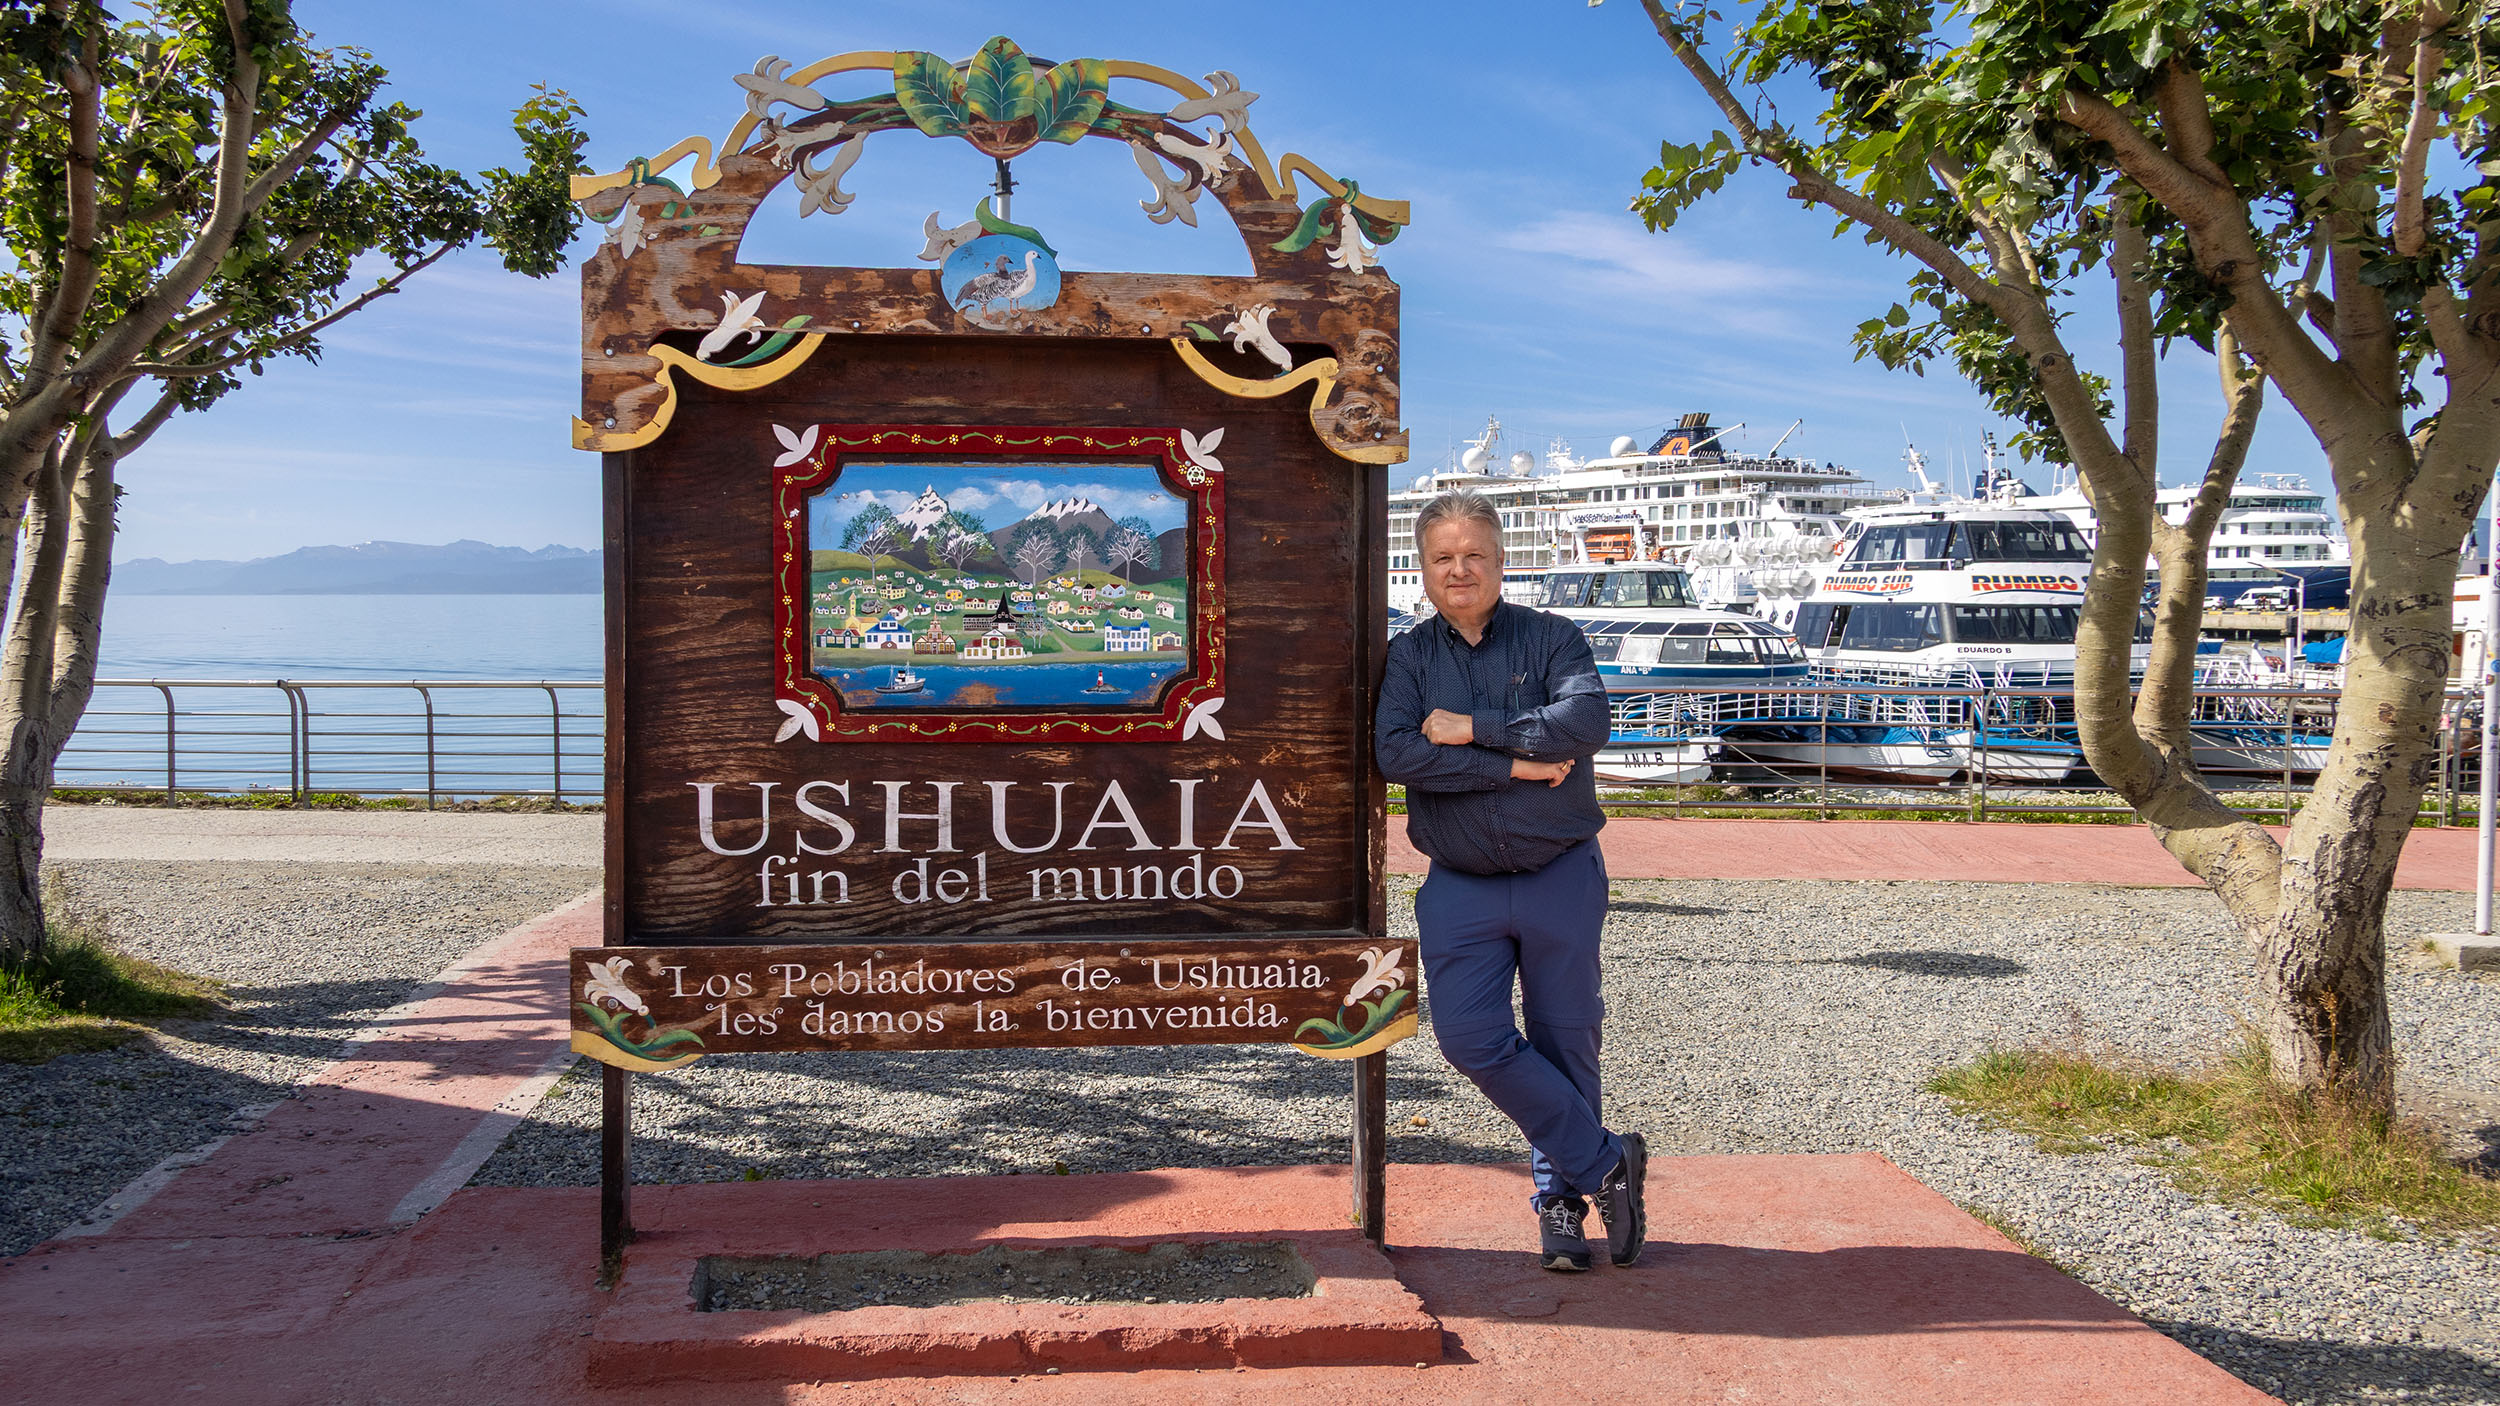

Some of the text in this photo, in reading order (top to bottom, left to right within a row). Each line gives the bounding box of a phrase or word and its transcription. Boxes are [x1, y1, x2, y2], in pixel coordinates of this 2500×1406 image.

[1823, 575, 1913, 591] RUMBO SUR
[1971, 575, 2078, 591] RUMBO
[1620, 665, 1637, 675] ANA
[1624, 751, 1664, 768] ANA B
[686, 778, 1305, 856] USHUAIA
[755, 852, 1245, 907] fin del mundo
[660, 957, 1330, 998] Los Pobladores de Ushuaia
[705, 996, 1288, 1036] les damos la bienvenida
